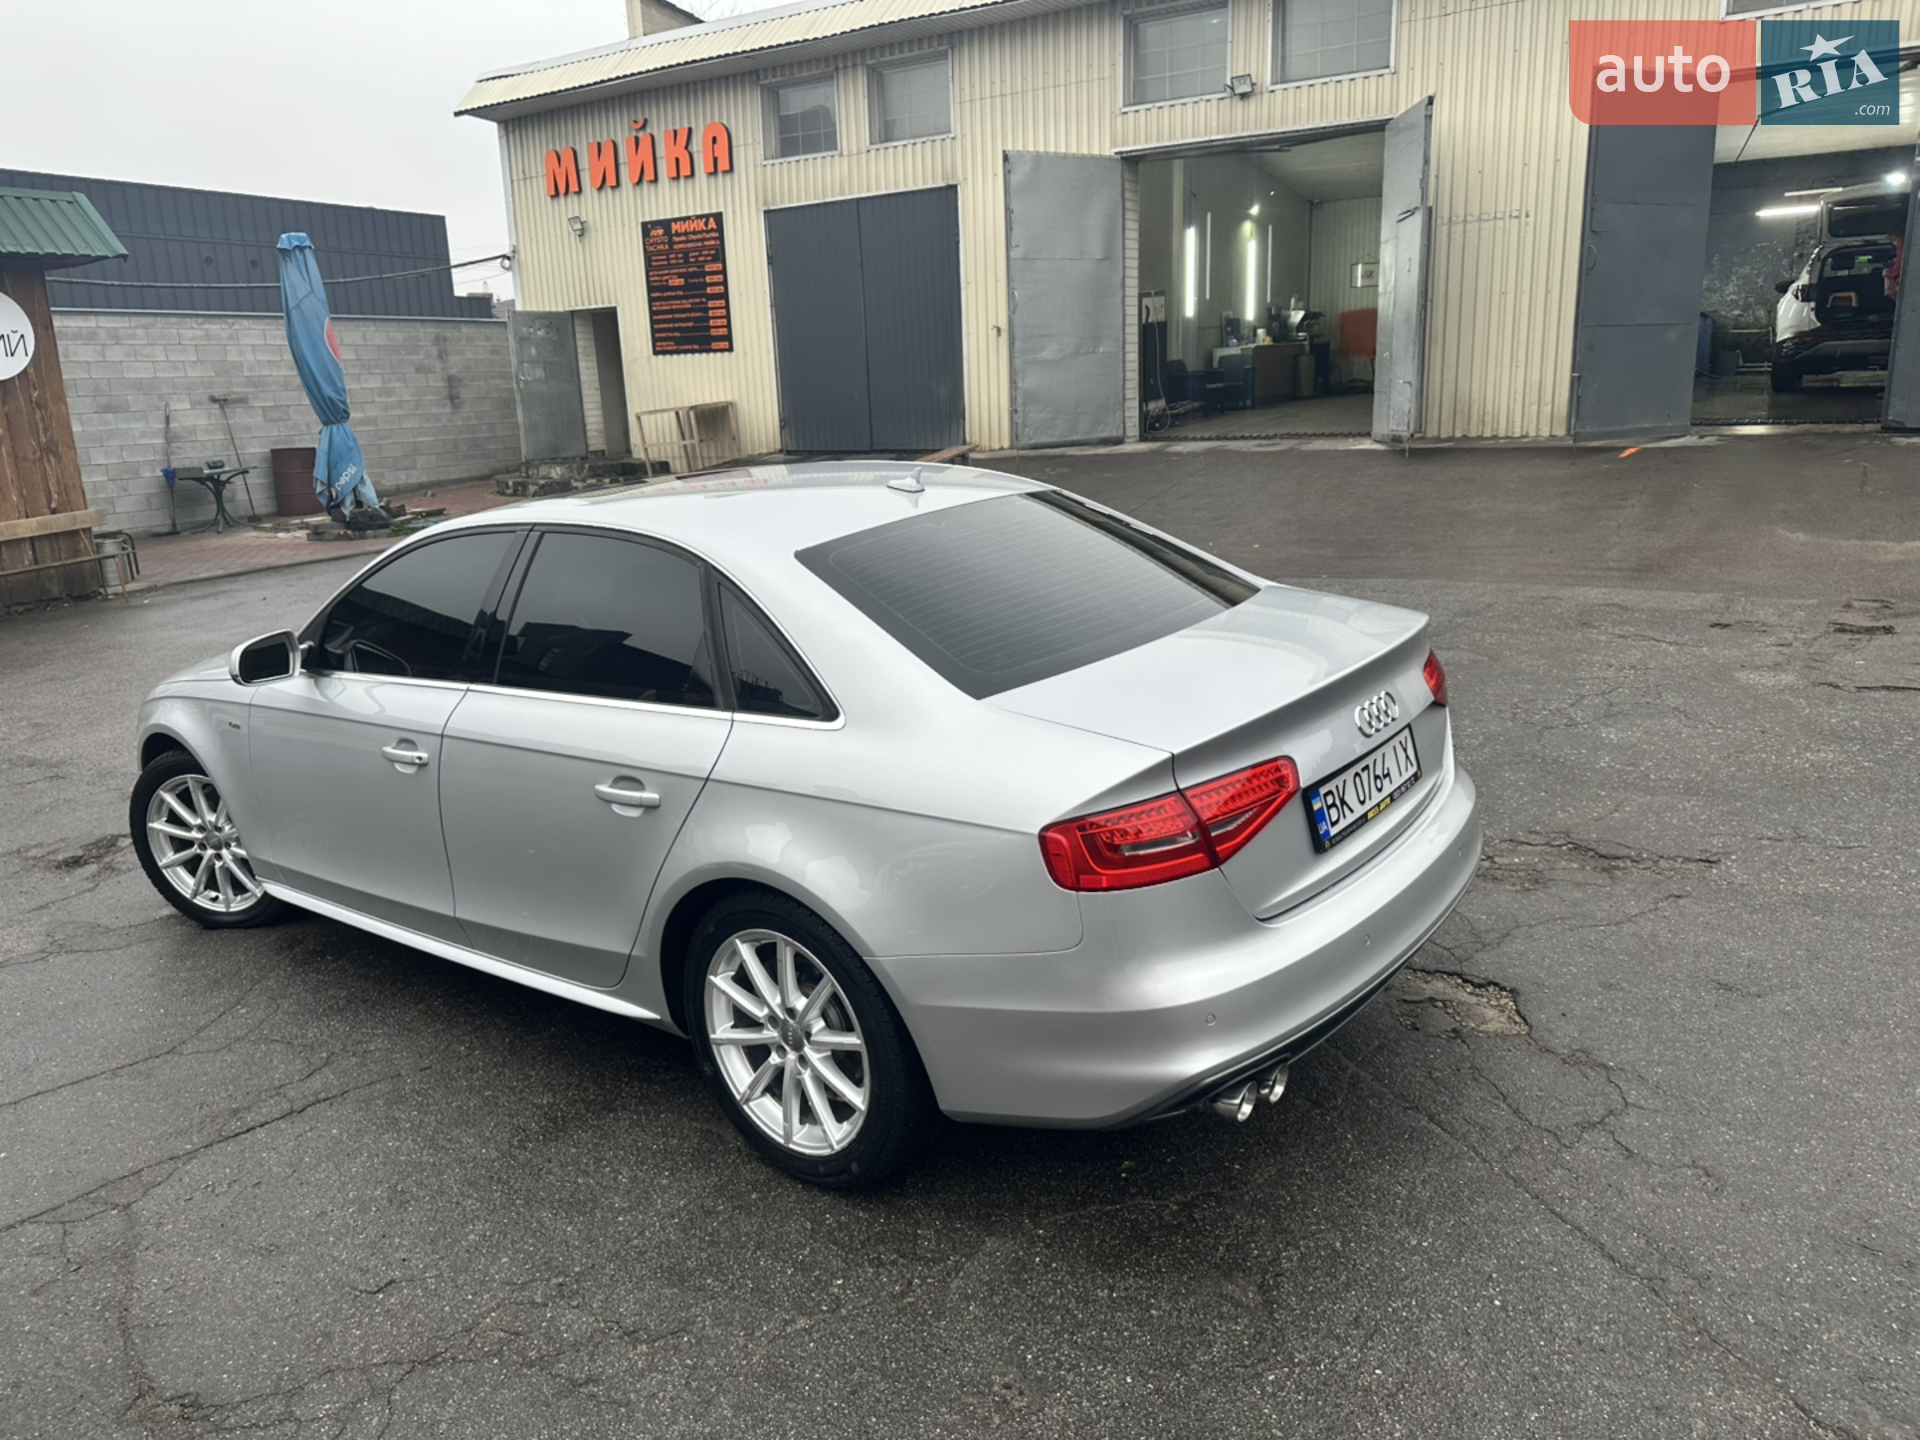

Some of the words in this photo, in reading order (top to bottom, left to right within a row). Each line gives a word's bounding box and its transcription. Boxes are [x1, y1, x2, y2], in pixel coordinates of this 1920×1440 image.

[545, 116, 733, 198] МИЙКА
[672, 216, 716, 233] МИЙКА
[645, 236, 668, 244] CHYSTO
[335, 463, 357, 491] pepsi
[1324, 778, 1354, 827] BK
[1353, 752, 1392, 805] 0764
[1393, 735, 1414, 776] IX
